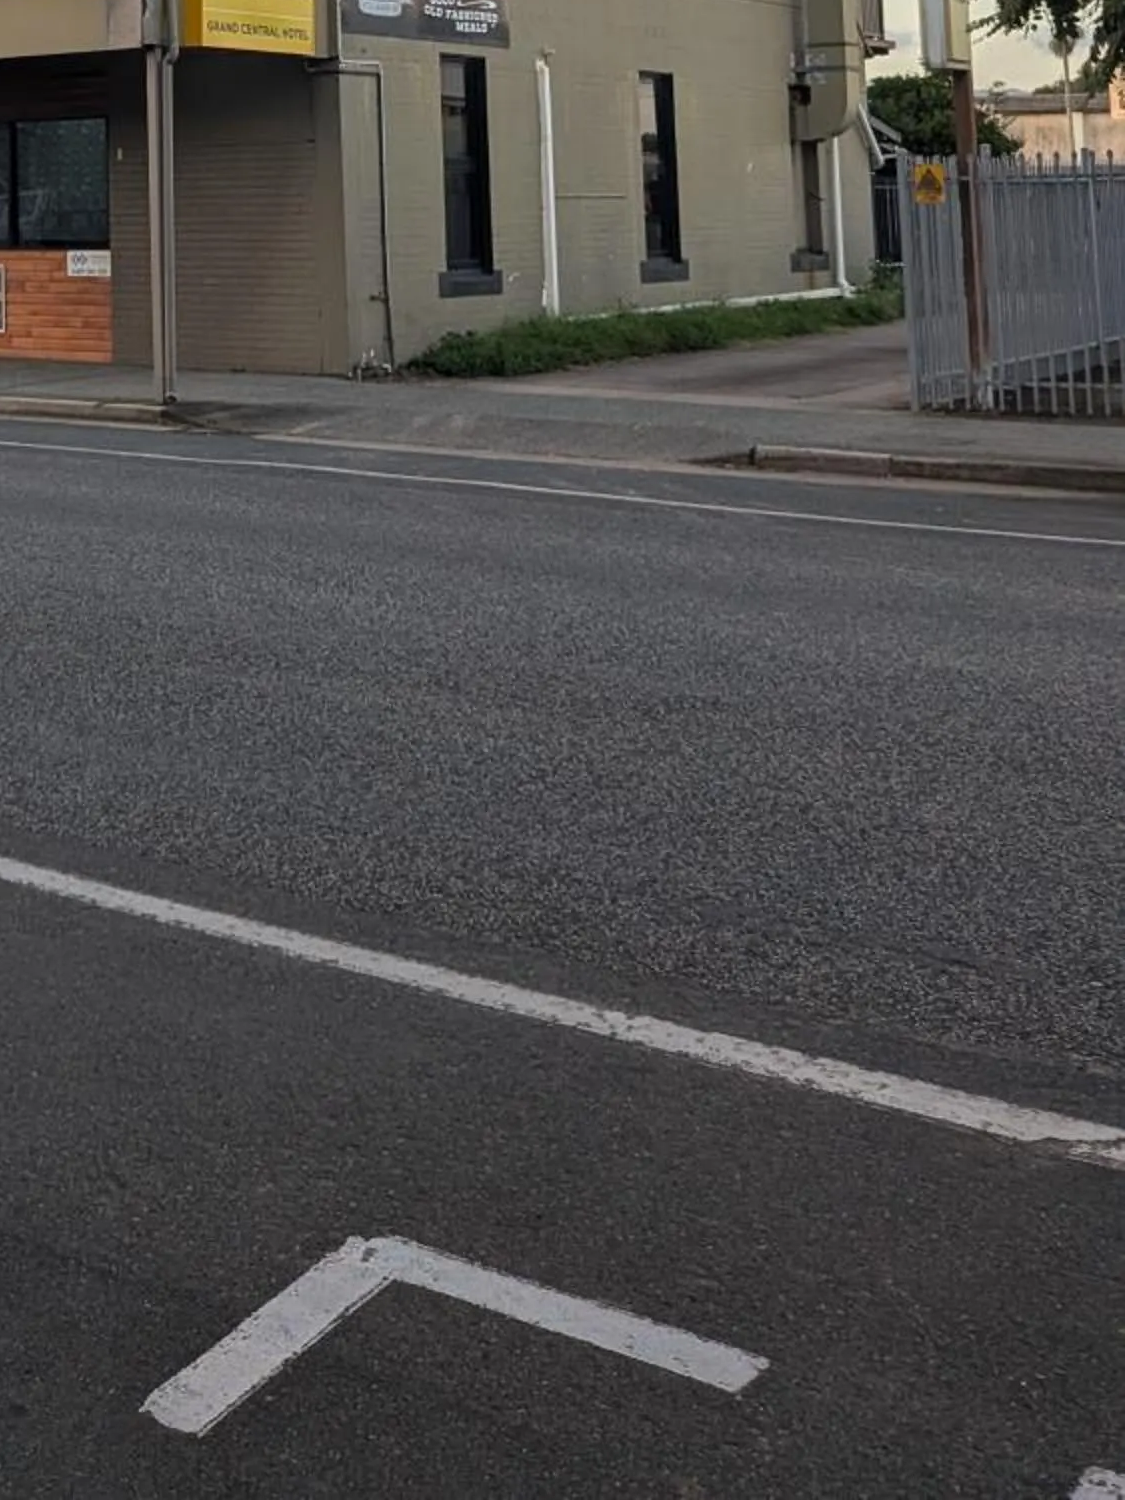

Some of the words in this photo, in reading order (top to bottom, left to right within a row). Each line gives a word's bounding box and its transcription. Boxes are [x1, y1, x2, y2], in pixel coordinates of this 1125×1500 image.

[424, 4, 443, 17] OLD
[207, 20, 239, 34] GRAND
[241, 23, 280, 38] CENTRAL
[282, 28, 309, 41] HOTEL
